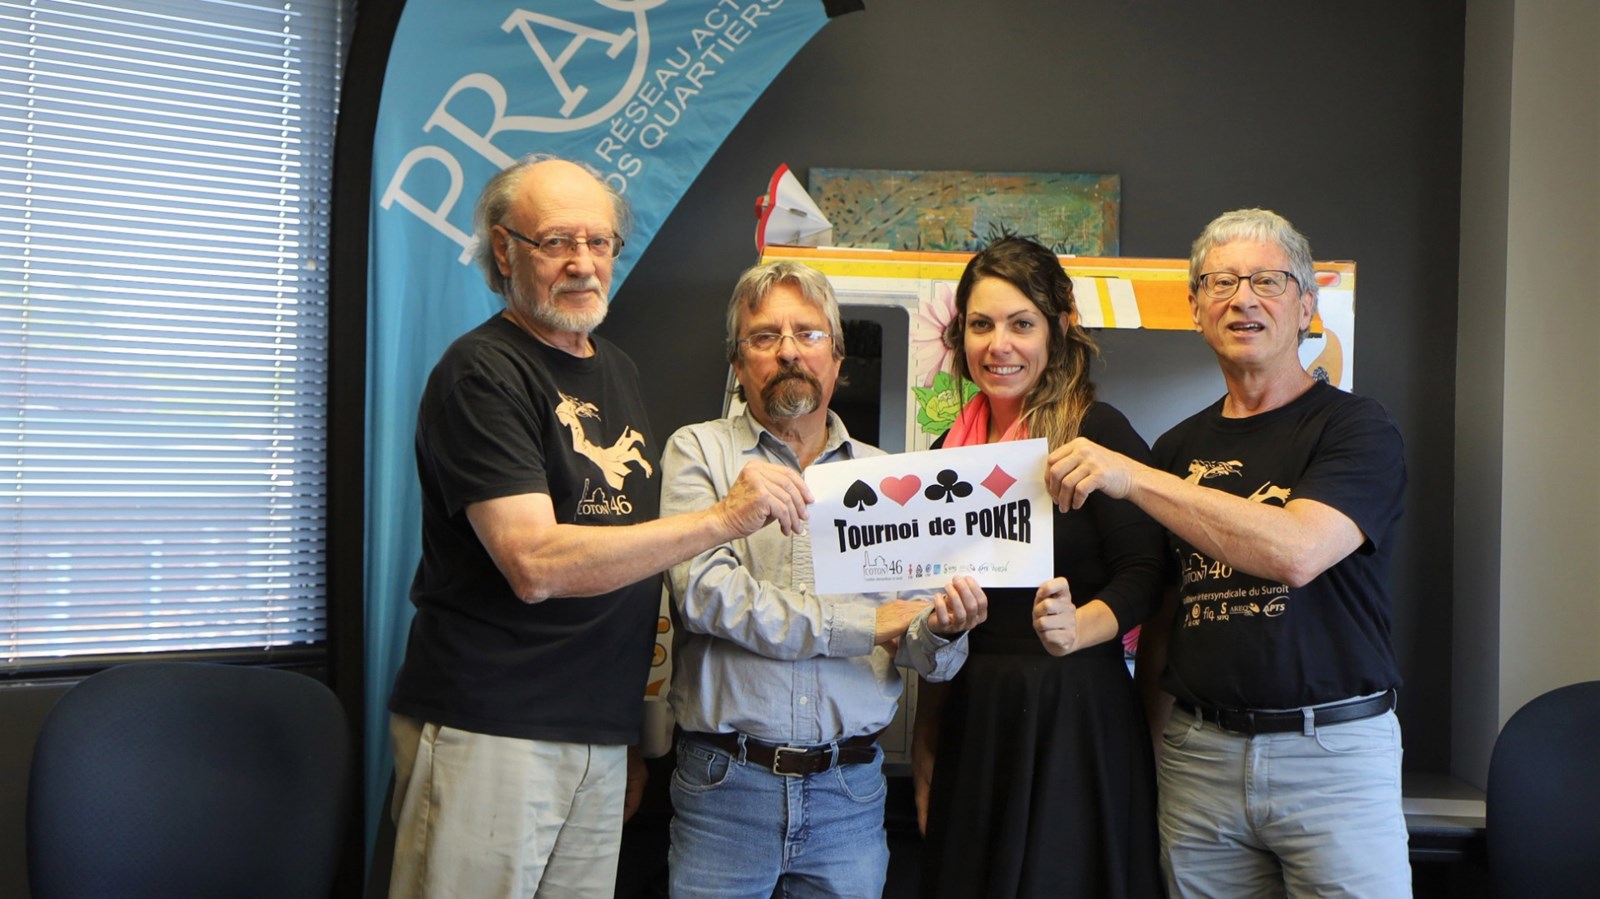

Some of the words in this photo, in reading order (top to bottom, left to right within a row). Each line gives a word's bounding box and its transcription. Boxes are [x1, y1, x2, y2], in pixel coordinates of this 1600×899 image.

[595, 46, 692, 162] RÉSEAU
[610, 494, 633, 516] 46
[834, 518, 919, 553] Tournoi
[929, 516, 956, 536] de
[966, 498, 1032, 544] POKER
[865, 567, 886, 576] COTON
[889, 559, 903, 575] 46
[1248, 587, 1260, 597] du
[1262, 603, 1287, 613] APTS
